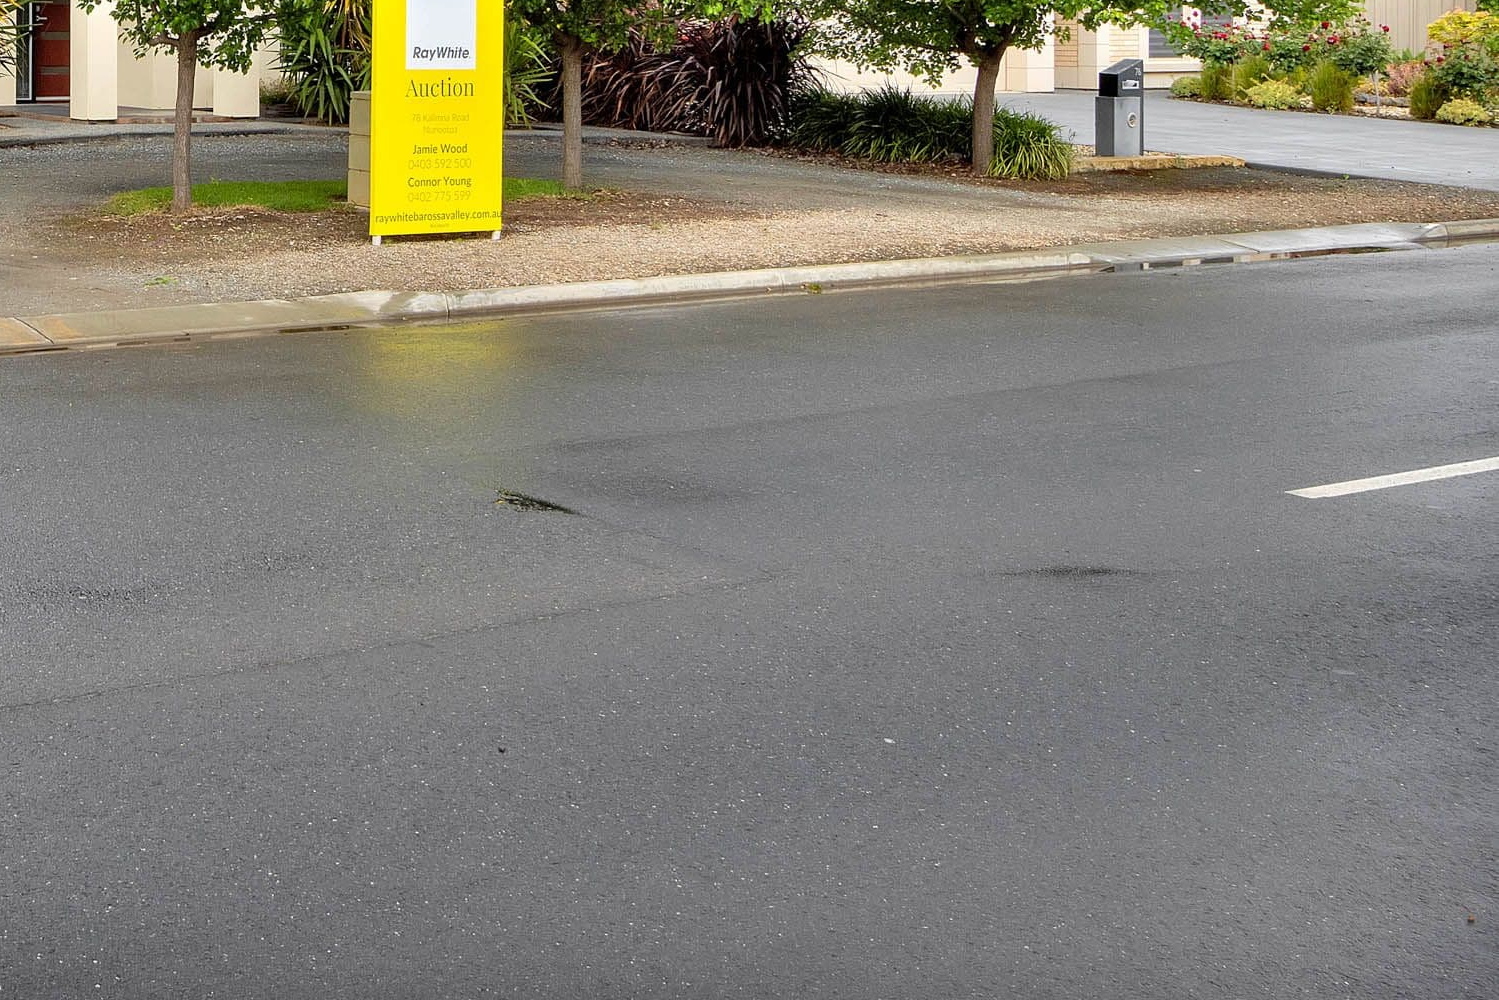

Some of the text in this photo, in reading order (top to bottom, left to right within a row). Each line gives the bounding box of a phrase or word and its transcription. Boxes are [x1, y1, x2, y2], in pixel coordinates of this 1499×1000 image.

[405, 77, 474, 97] Auction
[451, 112, 470, 122] Road
[412, 143, 468, 155] Jamie Wood
[434, 158, 452, 169] 592
[453, 157, 472, 169] 500
[407, 175, 472, 188] Connor Young
[434, 190, 451, 202] 775
[453, 189, 471, 202] 599
[375, 210, 502, 225] raywhitebarossavalley.com.au
